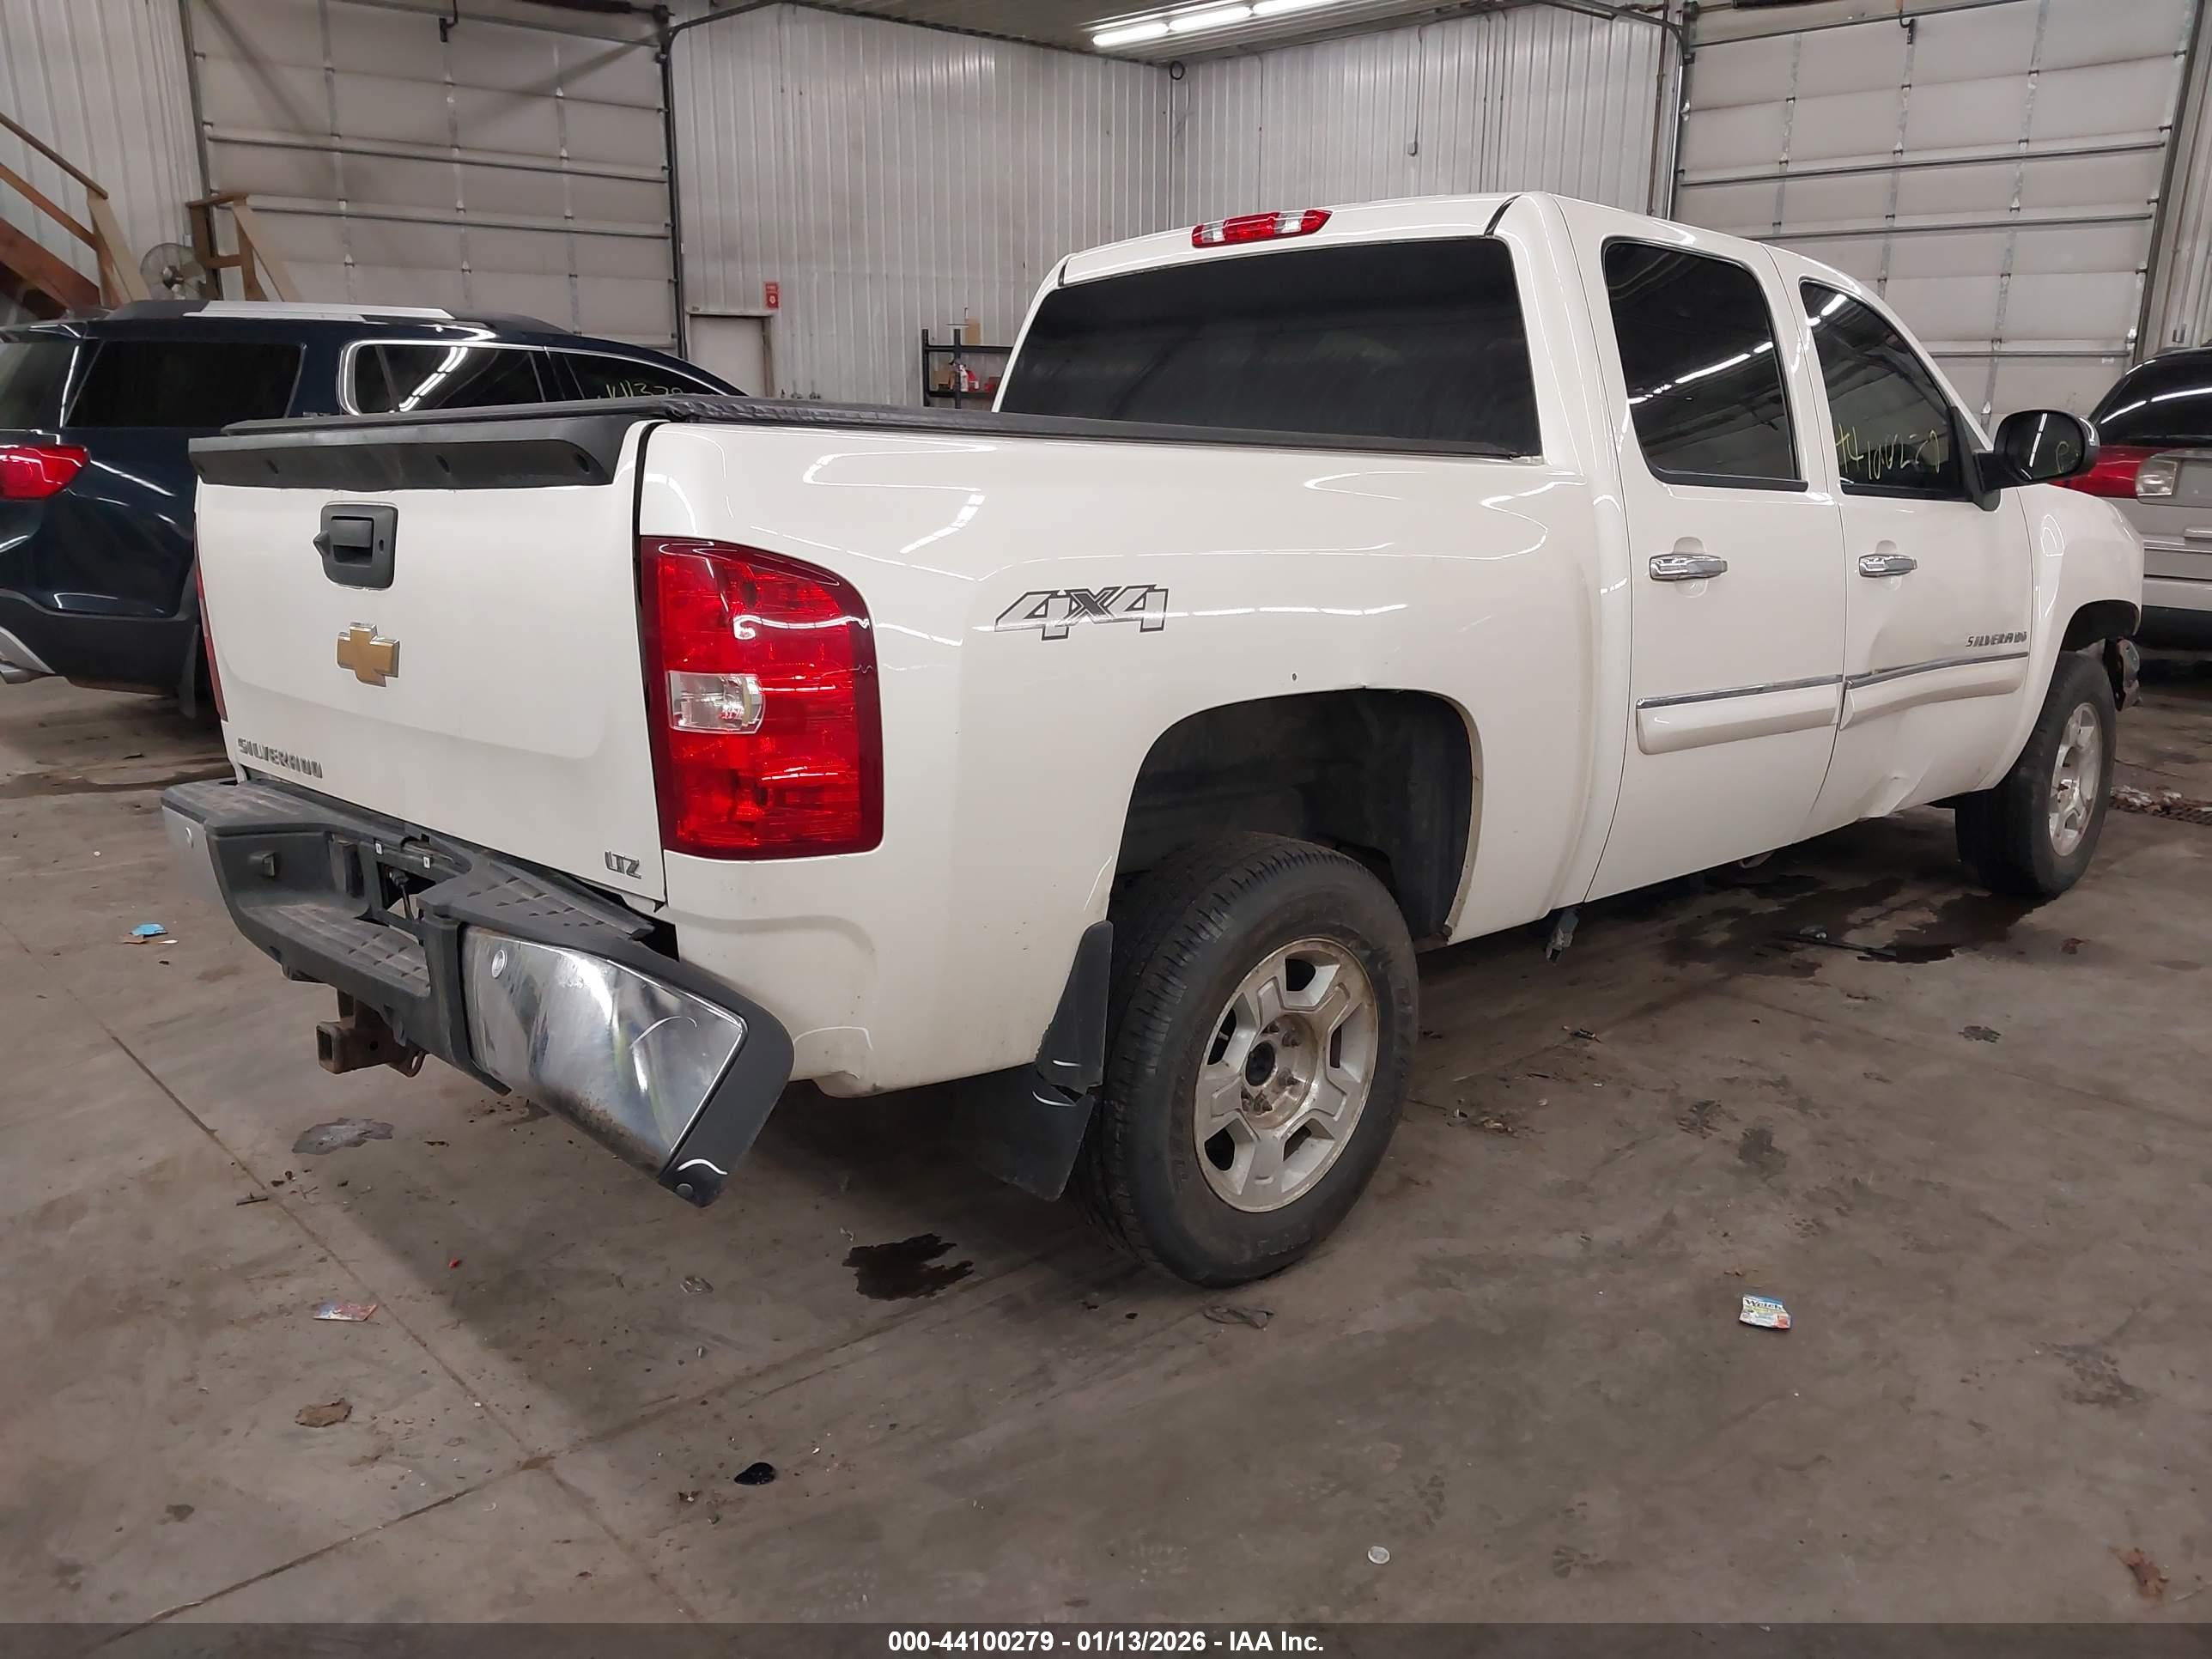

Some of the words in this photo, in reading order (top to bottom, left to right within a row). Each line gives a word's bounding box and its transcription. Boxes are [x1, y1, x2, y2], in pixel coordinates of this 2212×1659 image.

[994, 583, 1169, 641] 4X4
[1965, 631, 2027, 648] SILVERADO
[237, 737, 323, 779] SILVERADO
[605, 850, 642, 880] LTZ
